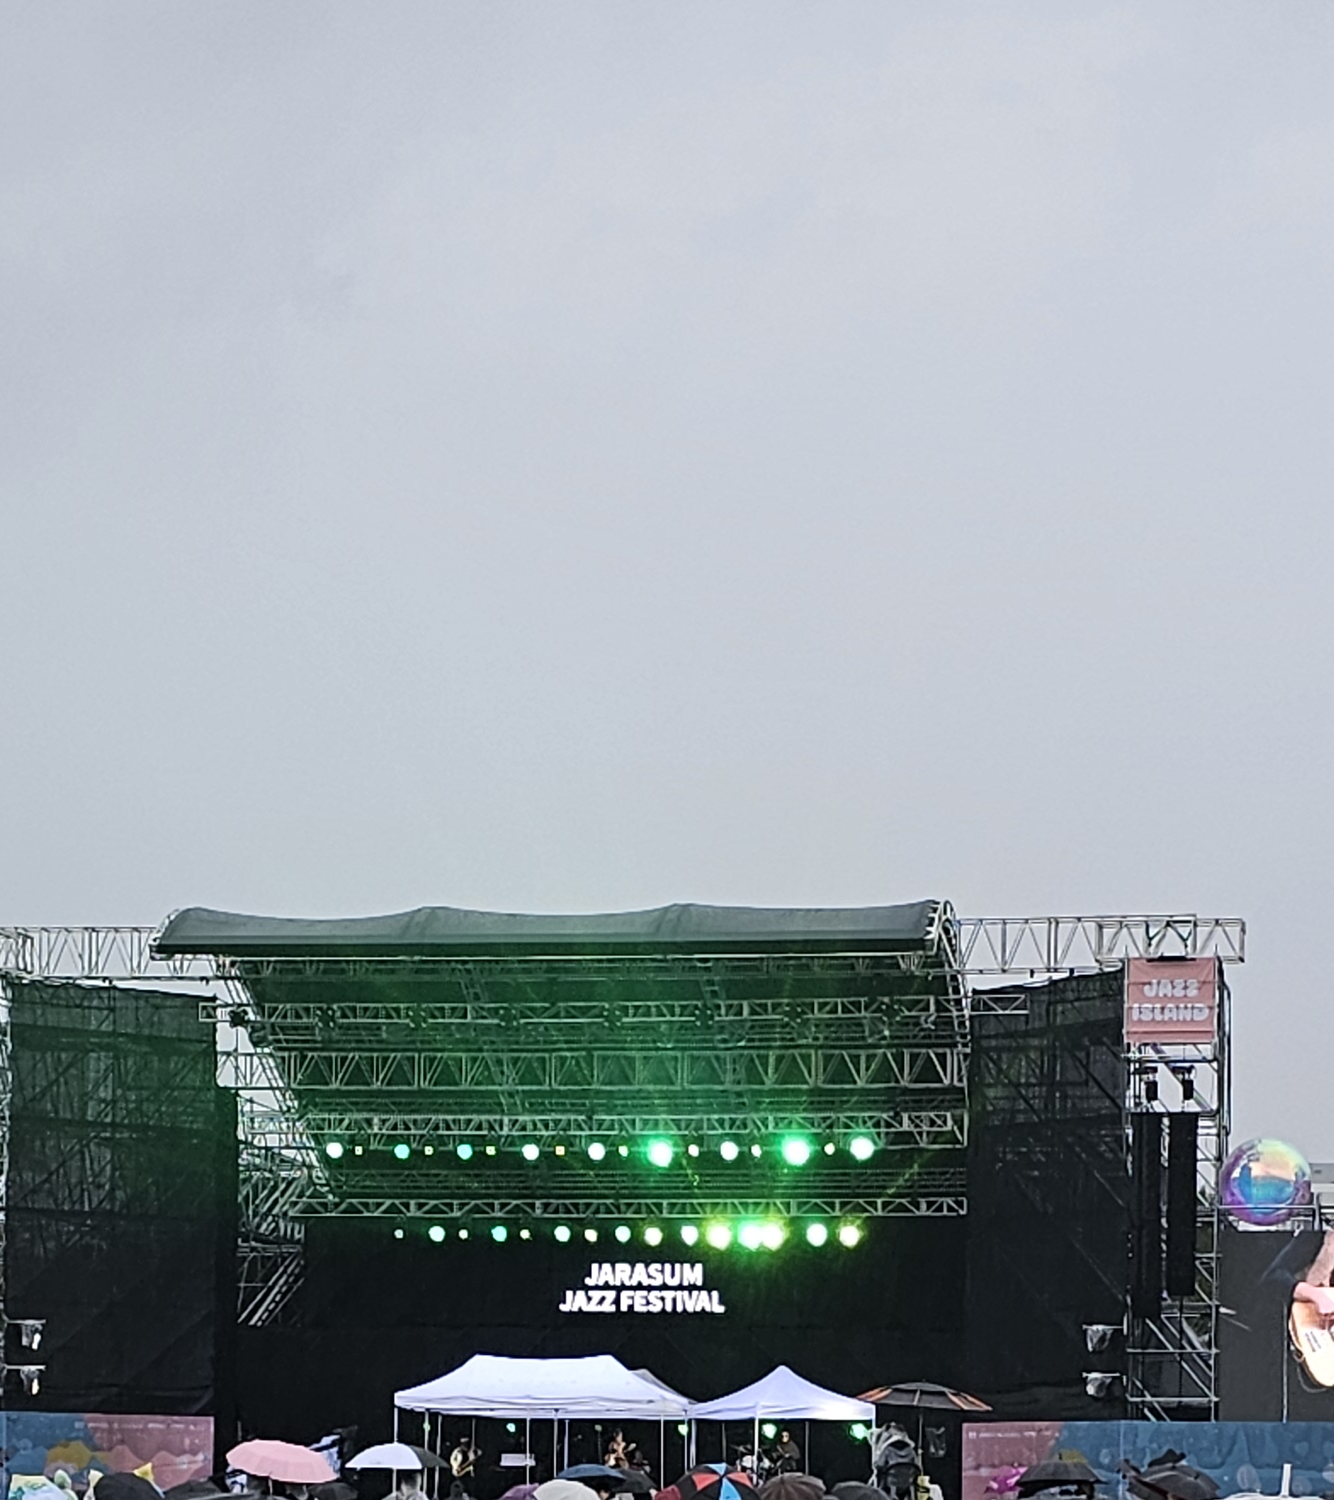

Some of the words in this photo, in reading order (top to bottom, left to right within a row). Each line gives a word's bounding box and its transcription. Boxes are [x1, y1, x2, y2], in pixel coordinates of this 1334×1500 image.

[1143, 979, 1200, 998] JAZZ
[1132, 1003, 1210, 1022] ISLAND
[584, 1262, 704, 1287] JARASUM
[558, 1290, 617, 1312] JAZZ
[619, 1290, 726, 1314] FESTIVAL
